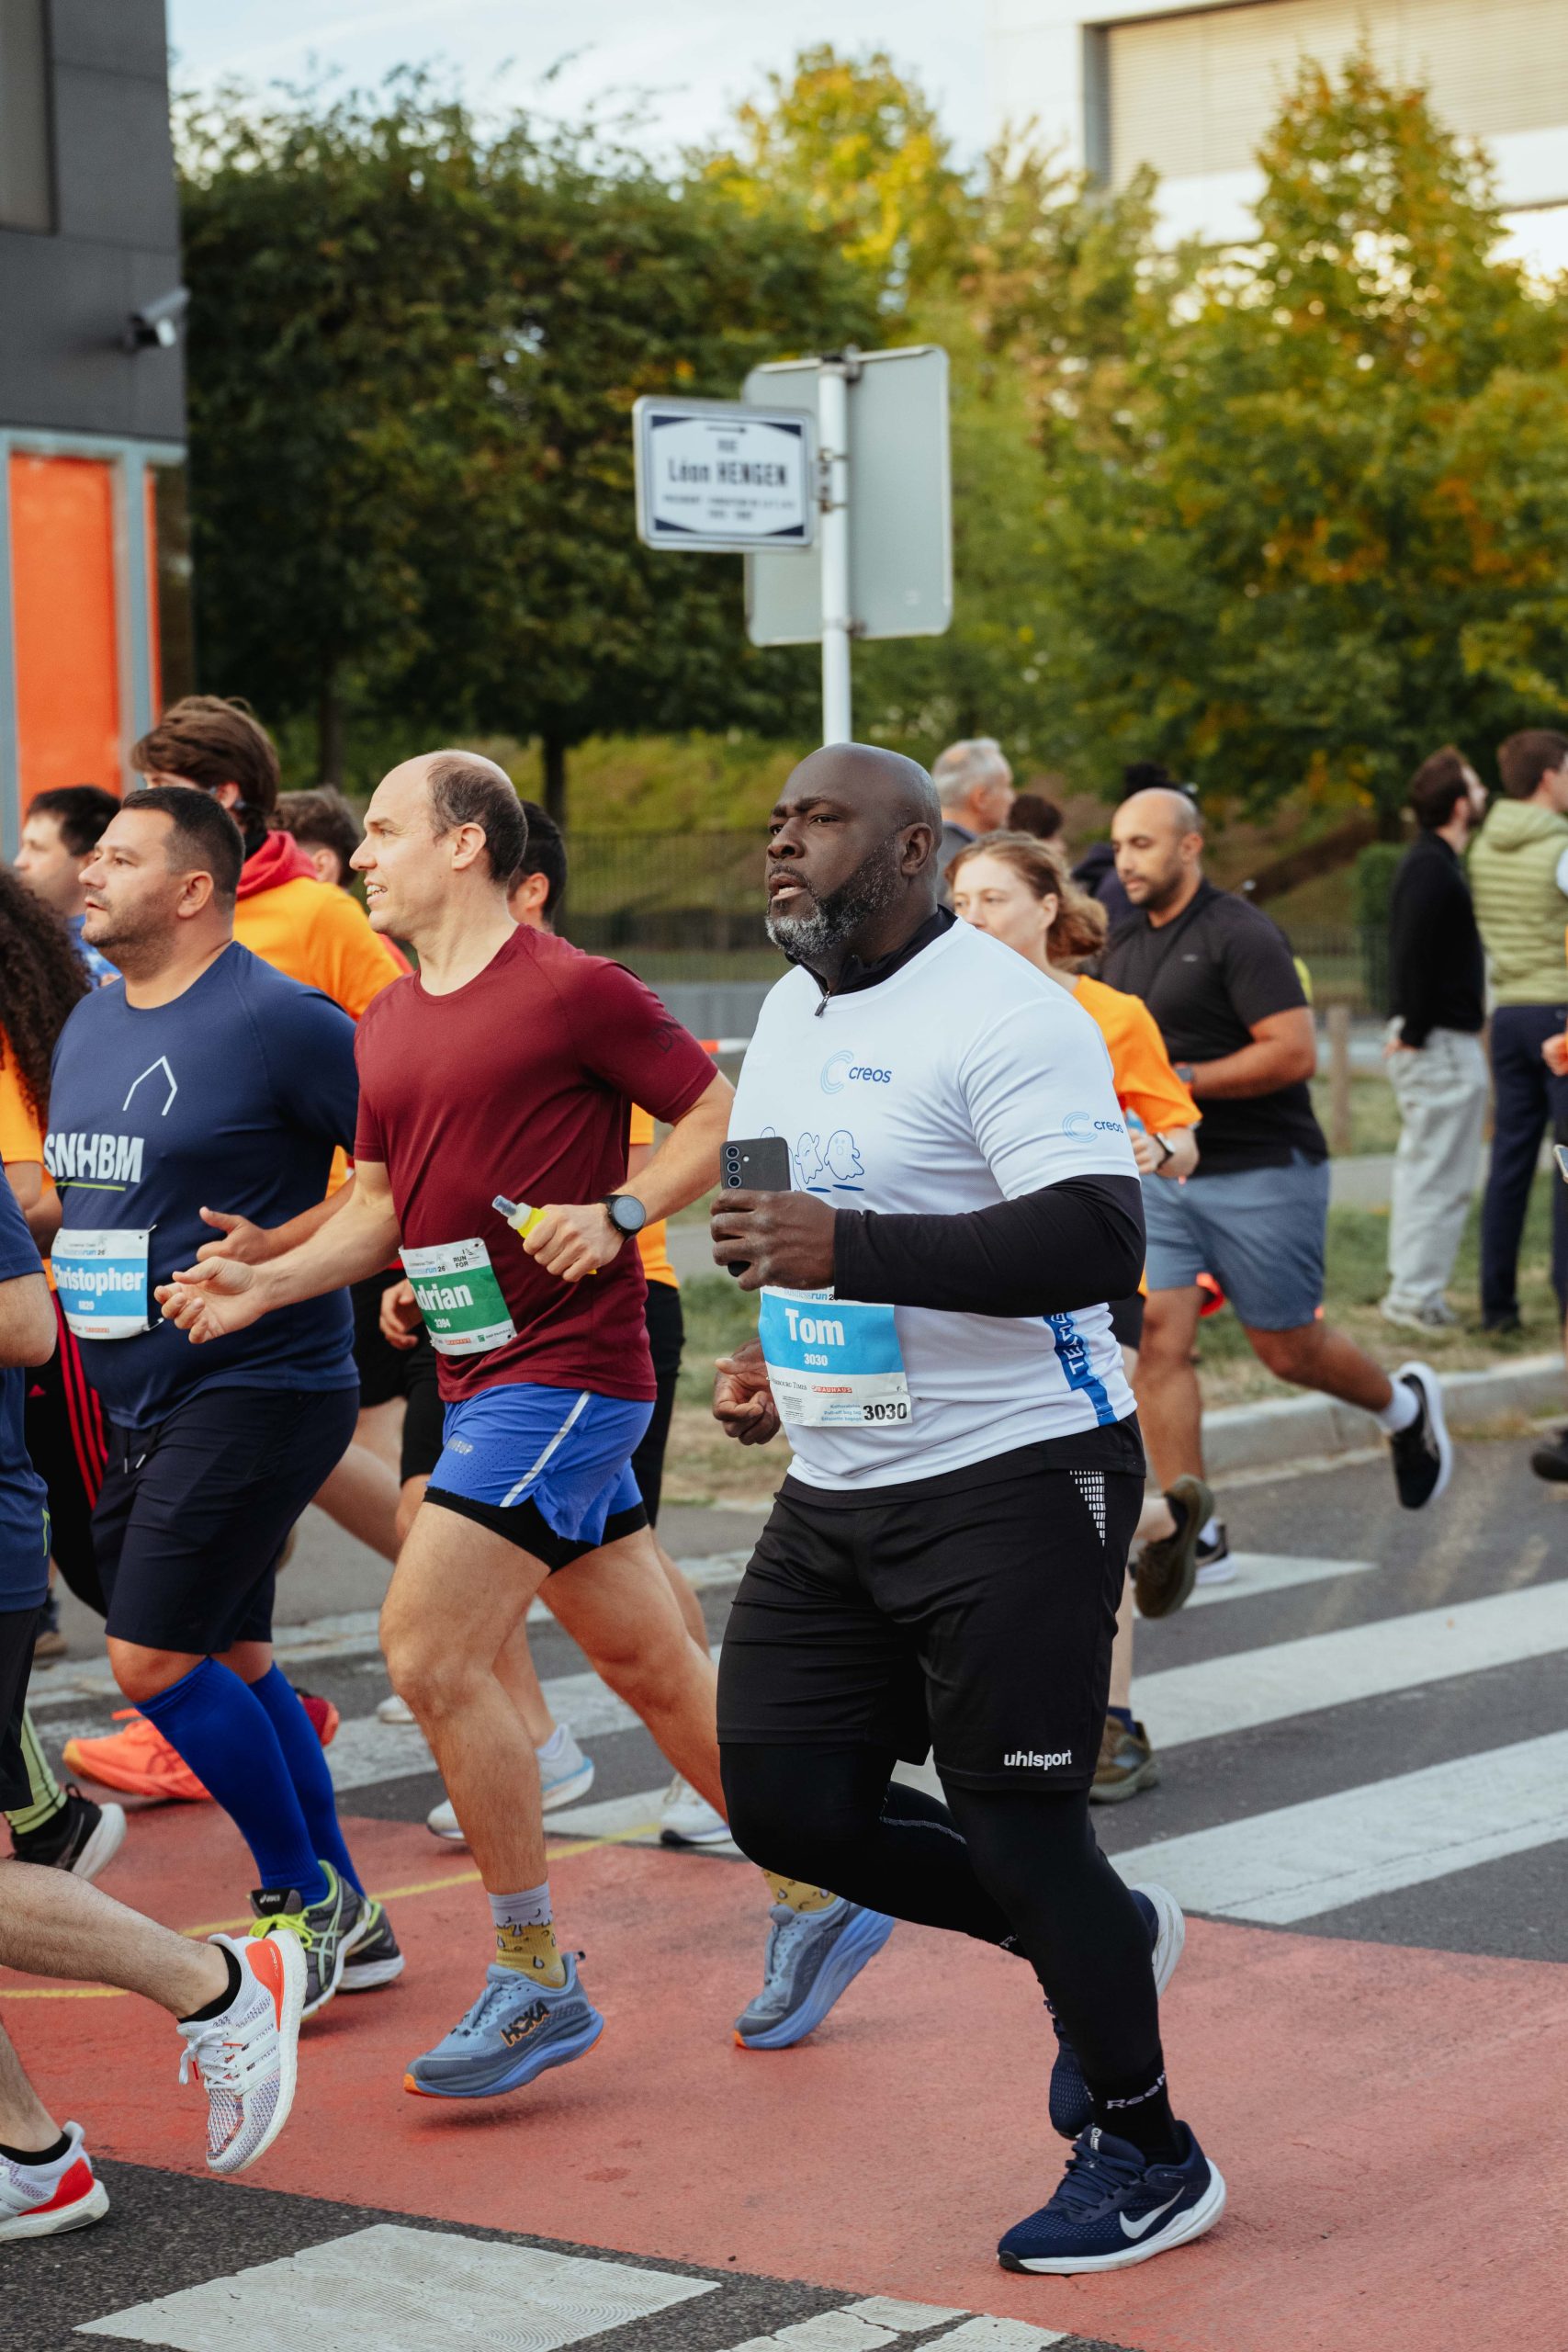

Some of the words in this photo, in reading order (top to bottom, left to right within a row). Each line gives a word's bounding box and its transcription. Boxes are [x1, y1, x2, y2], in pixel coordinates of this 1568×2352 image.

[717, 461, 787, 487] HENGEN
[849, 1066, 892, 1083] creos
[1093, 1120, 1124, 1134] creos
[43, 1133, 145, 1182] SNHBM
[453, 1255, 467, 1263] RUN
[417, 1283, 474, 1311] drian
[785, 1307, 845, 1346] Tom
[804, 1352, 828, 1366] 3030
[863, 1402, 908, 1421] 3030
[1003, 1749, 1072, 1770] uhlsport
[501, 1999, 549, 2047] HOKA
